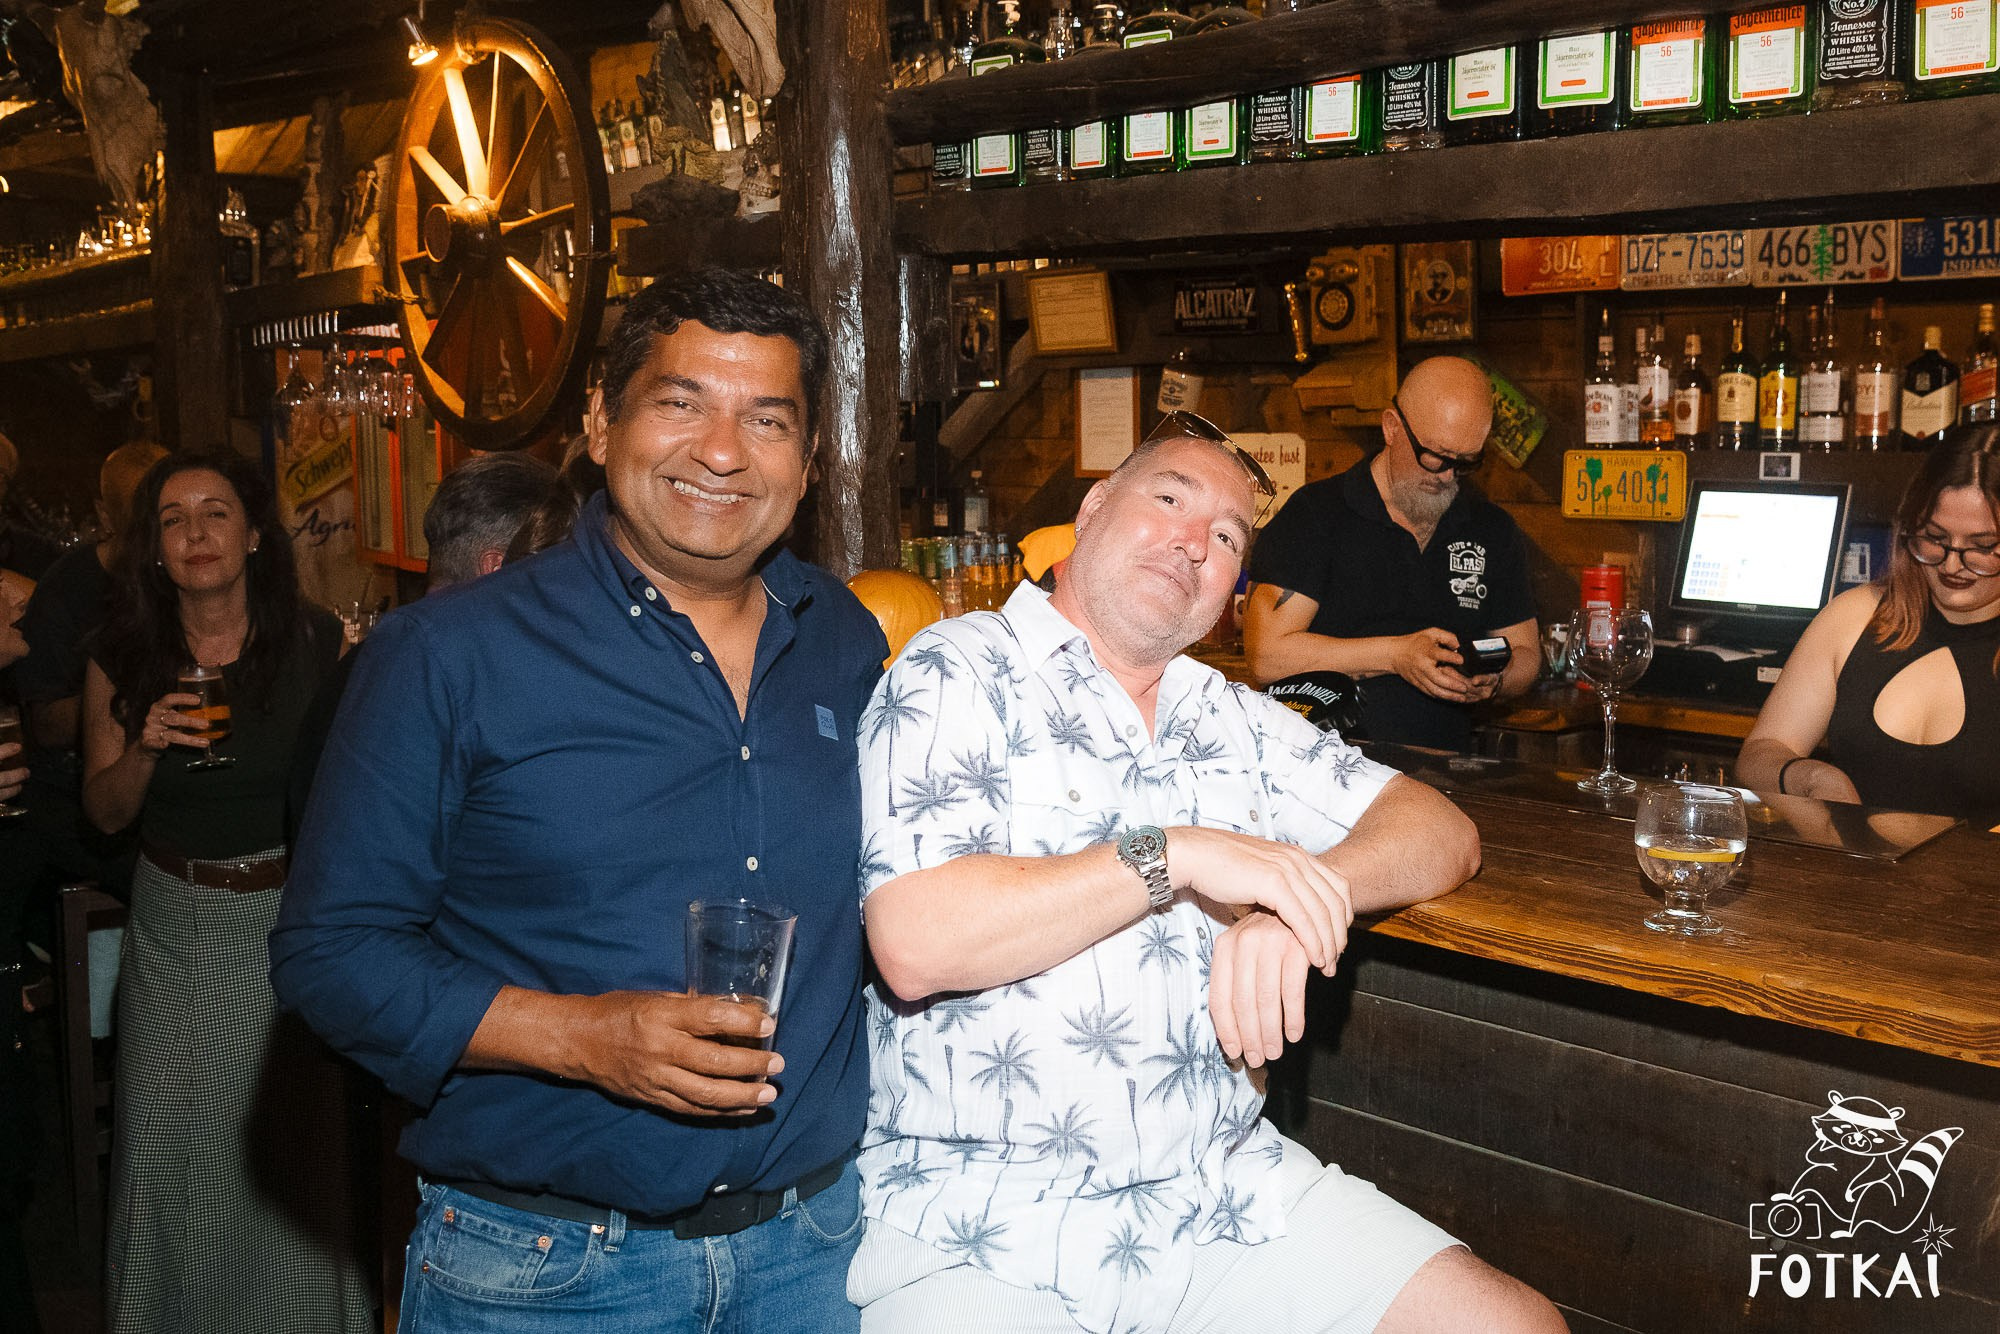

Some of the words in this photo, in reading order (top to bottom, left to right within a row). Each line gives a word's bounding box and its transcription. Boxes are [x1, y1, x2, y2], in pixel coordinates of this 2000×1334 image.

[1950, 6, 1964, 20] 56
[1830, 20, 1877, 33] Tennessee
[1760, 35, 1772, 48] 56
[1830, 33, 1876, 46] WHISKEY
[1660, 45, 1672, 58] 56
[1851, 45, 1866, 53] 40%
[1328, 86, 1337, 97] 56
[1388, 81, 1421, 91] Tennessee
[1389, 92, 1420, 102] WHISKEY
[1257, 105, 1287, 115] WHISKEY
[1758, 228, 1811, 269] 466
[1832, 223, 1887, 266] BYS
[1538, 239, 1584, 275] 304
[1626, 233, 1744, 274] DZF-7639
[1632, 274, 1674, 287] NORTH
[1175, 287, 1257, 320] ALCATRAZ
[1452, 556, 1463, 570] EL
[1266, 684, 1300, 698] JACK
